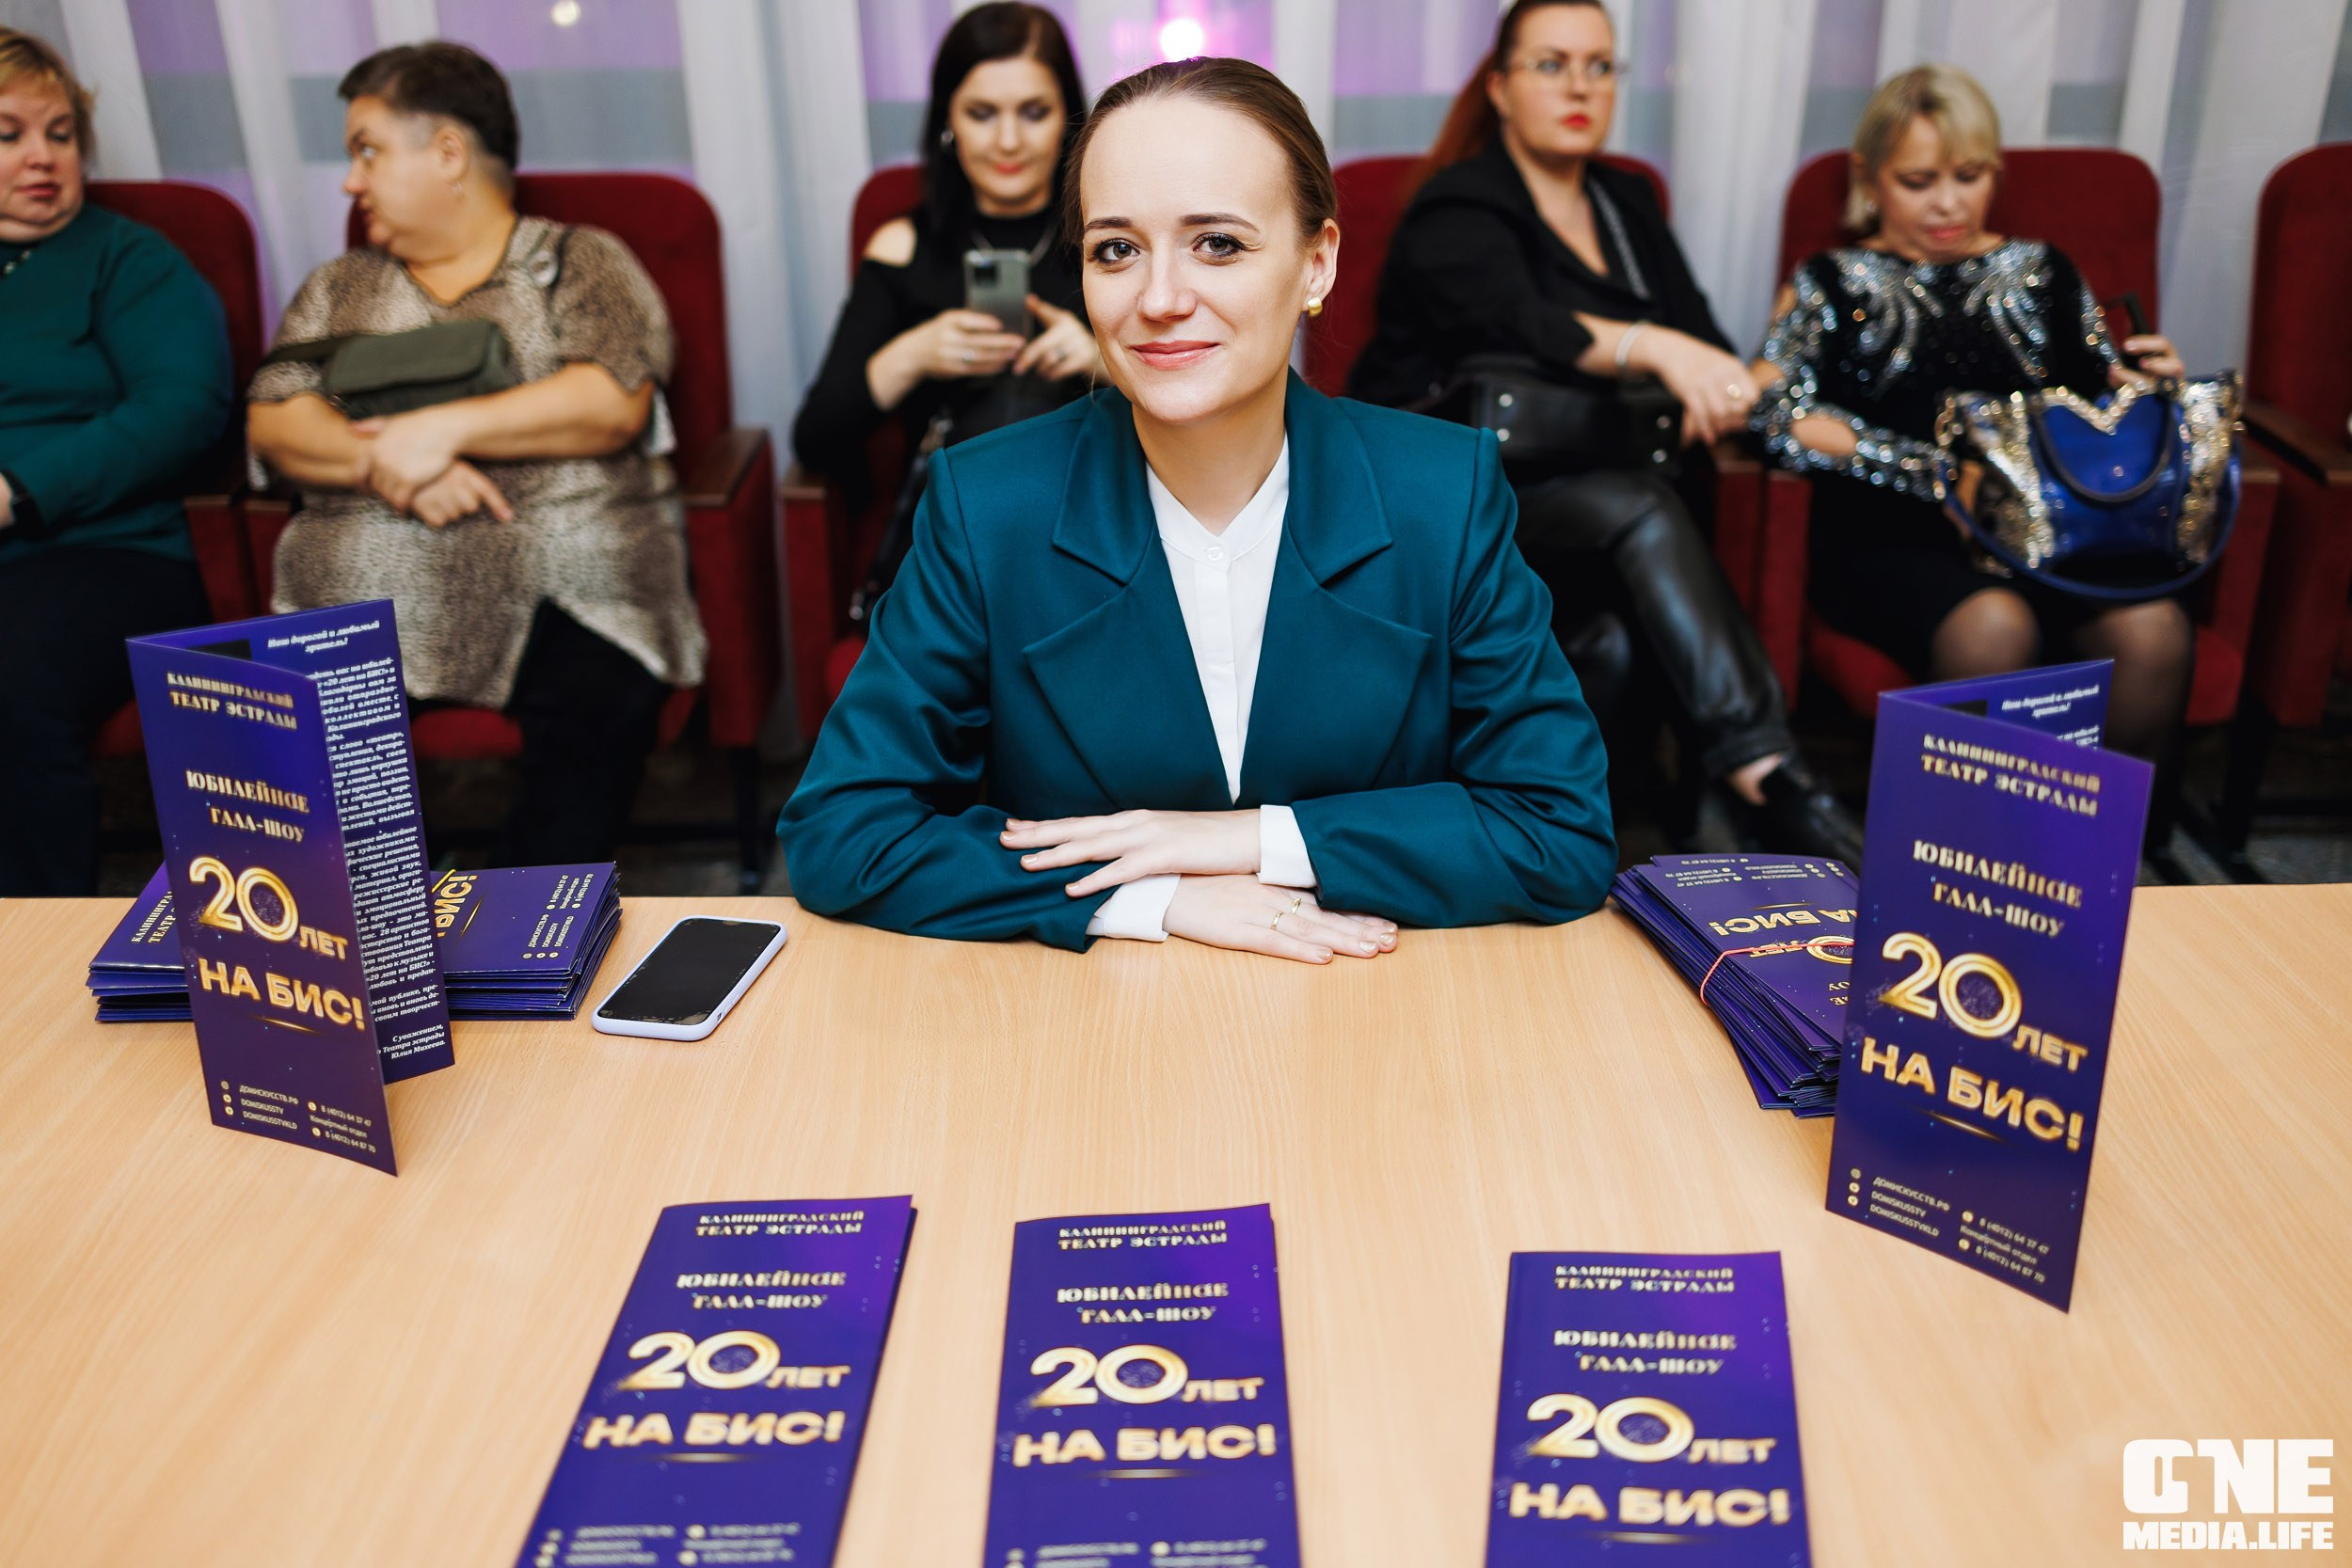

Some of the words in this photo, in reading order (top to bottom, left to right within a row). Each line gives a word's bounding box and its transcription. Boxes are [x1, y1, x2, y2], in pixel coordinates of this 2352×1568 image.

[170, 690, 220, 713] ТЕАТР
[226, 702, 297, 730] ЭСТРАДЫ
[186, 769, 310, 814] ЮБИЛЕЙНОЕ
[1921, 752, 1989, 785] ТЕАТР
[1994, 773, 2098, 816] ЭСТРАДЫ
[210, 807, 305, 843] ГАЛА-ШОУ
[371, 863, 399, 878] живой
[401, 860, 421, 871] звук,
[398, 868, 422, 881] ориги-
[1913, 838, 2084, 910] ЮБИЛЕЙНОЕ
[380, 885, 425, 901] атмосферу
[188, 856, 299, 942] 20
[300, 926, 348, 960] ЛЕТ
[396, 914, 412, 924] это
[414, 911, 428, 919] ма-
[1931, 880, 2066, 938] ГАЛА-ШОУ
[148, 914, 177, 942] ТЕАТР
[361, 932, 376, 941] вас.
[390, 918, 429, 935] артистов
[410, 927, 431, 937] бога-
[1708, 909, 1820, 936] БИС!
[404, 935, 432, 947] Театра
[377, 942, 433, 964] представлены
[399, 953, 428, 967] музыке
[369, 977, 397, 990] любовь
[407, 967, 437, 981] предан-
[380, 969, 397, 978] лет
[409, 958, 431, 971] БИС!»
[199, 958, 262, 1001] НА
[266, 973, 367, 1031] БИС!
[377, 1003, 399, 1014] вновь
[405, 994, 427, 1006] вновь
[389, 988, 421, 1004] публике,
[422, 983, 438, 994] пре-
[1880, 931, 2022, 1038] 20
[2013, 1028, 2089, 1072] ЛЕТ
[374, 1010, 399, 1022] своим
[400, 1000, 440, 1015] творчест-
[382, 1040, 410, 1053] Театра
[412, 1030, 445, 1045] эстрады
[397, 1023, 444, 1042] уважением,
[391, 1049, 412, 1060] Юлия
[414, 1040, 446, 1054] Михеева.
[1859, 1037, 1935, 1095] НА
[1947, 1066, 2084, 1151] БИС!
[347, 1113, 355, 1121] 64
[696, 1224, 758, 1237] ТЕАТР
[765, 1222, 862, 1234] ЭСТРАДЫ
[1057, 1238, 1123, 1251] ТЕАТР
[1130, 1232, 1227, 1247] ЭСТРАДЫ
[676, 1270, 847, 1289] ЮБИЛЕЙНОЕ
[1554, 1277, 1623, 1291] ТЕАТР
[1629, 1279, 1735, 1292] ЭСТРАДЫ
[692, 1294, 828, 1309] ГАЛА-ШОУ
[1057, 1282, 1229, 1303] ЮБИЛЕЙНОЕ
[1080, 1306, 1216, 1324] ГАЛА-ШОУ
[1553, 1328, 1737, 1351] ЮБИЛЕЙНОЕ
[617, 1330, 781, 1390] 20
[766, 1364, 851, 1388] ЛЕТ
[1579, 1354, 1724, 1375] ГАЛА-ШОУ
[1030, 1343, 1189, 1407] 20
[1182, 1377, 1264, 1402] ЛЕТ
[581, 1413, 674, 1449] НА
[684, 1411, 846, 1445] БИС!
[1526, 1392, 1693, 1462] 20
[1688, 1437, 1776, 1464] ЛЕТ
[1012, 1428, 1106, 1467] НА
[1116, 1422, 1276, 1462] БИС!
[1509, 1482, 1608, 1521] НА
[1618, 1486, 1791, 1527] БИС!
